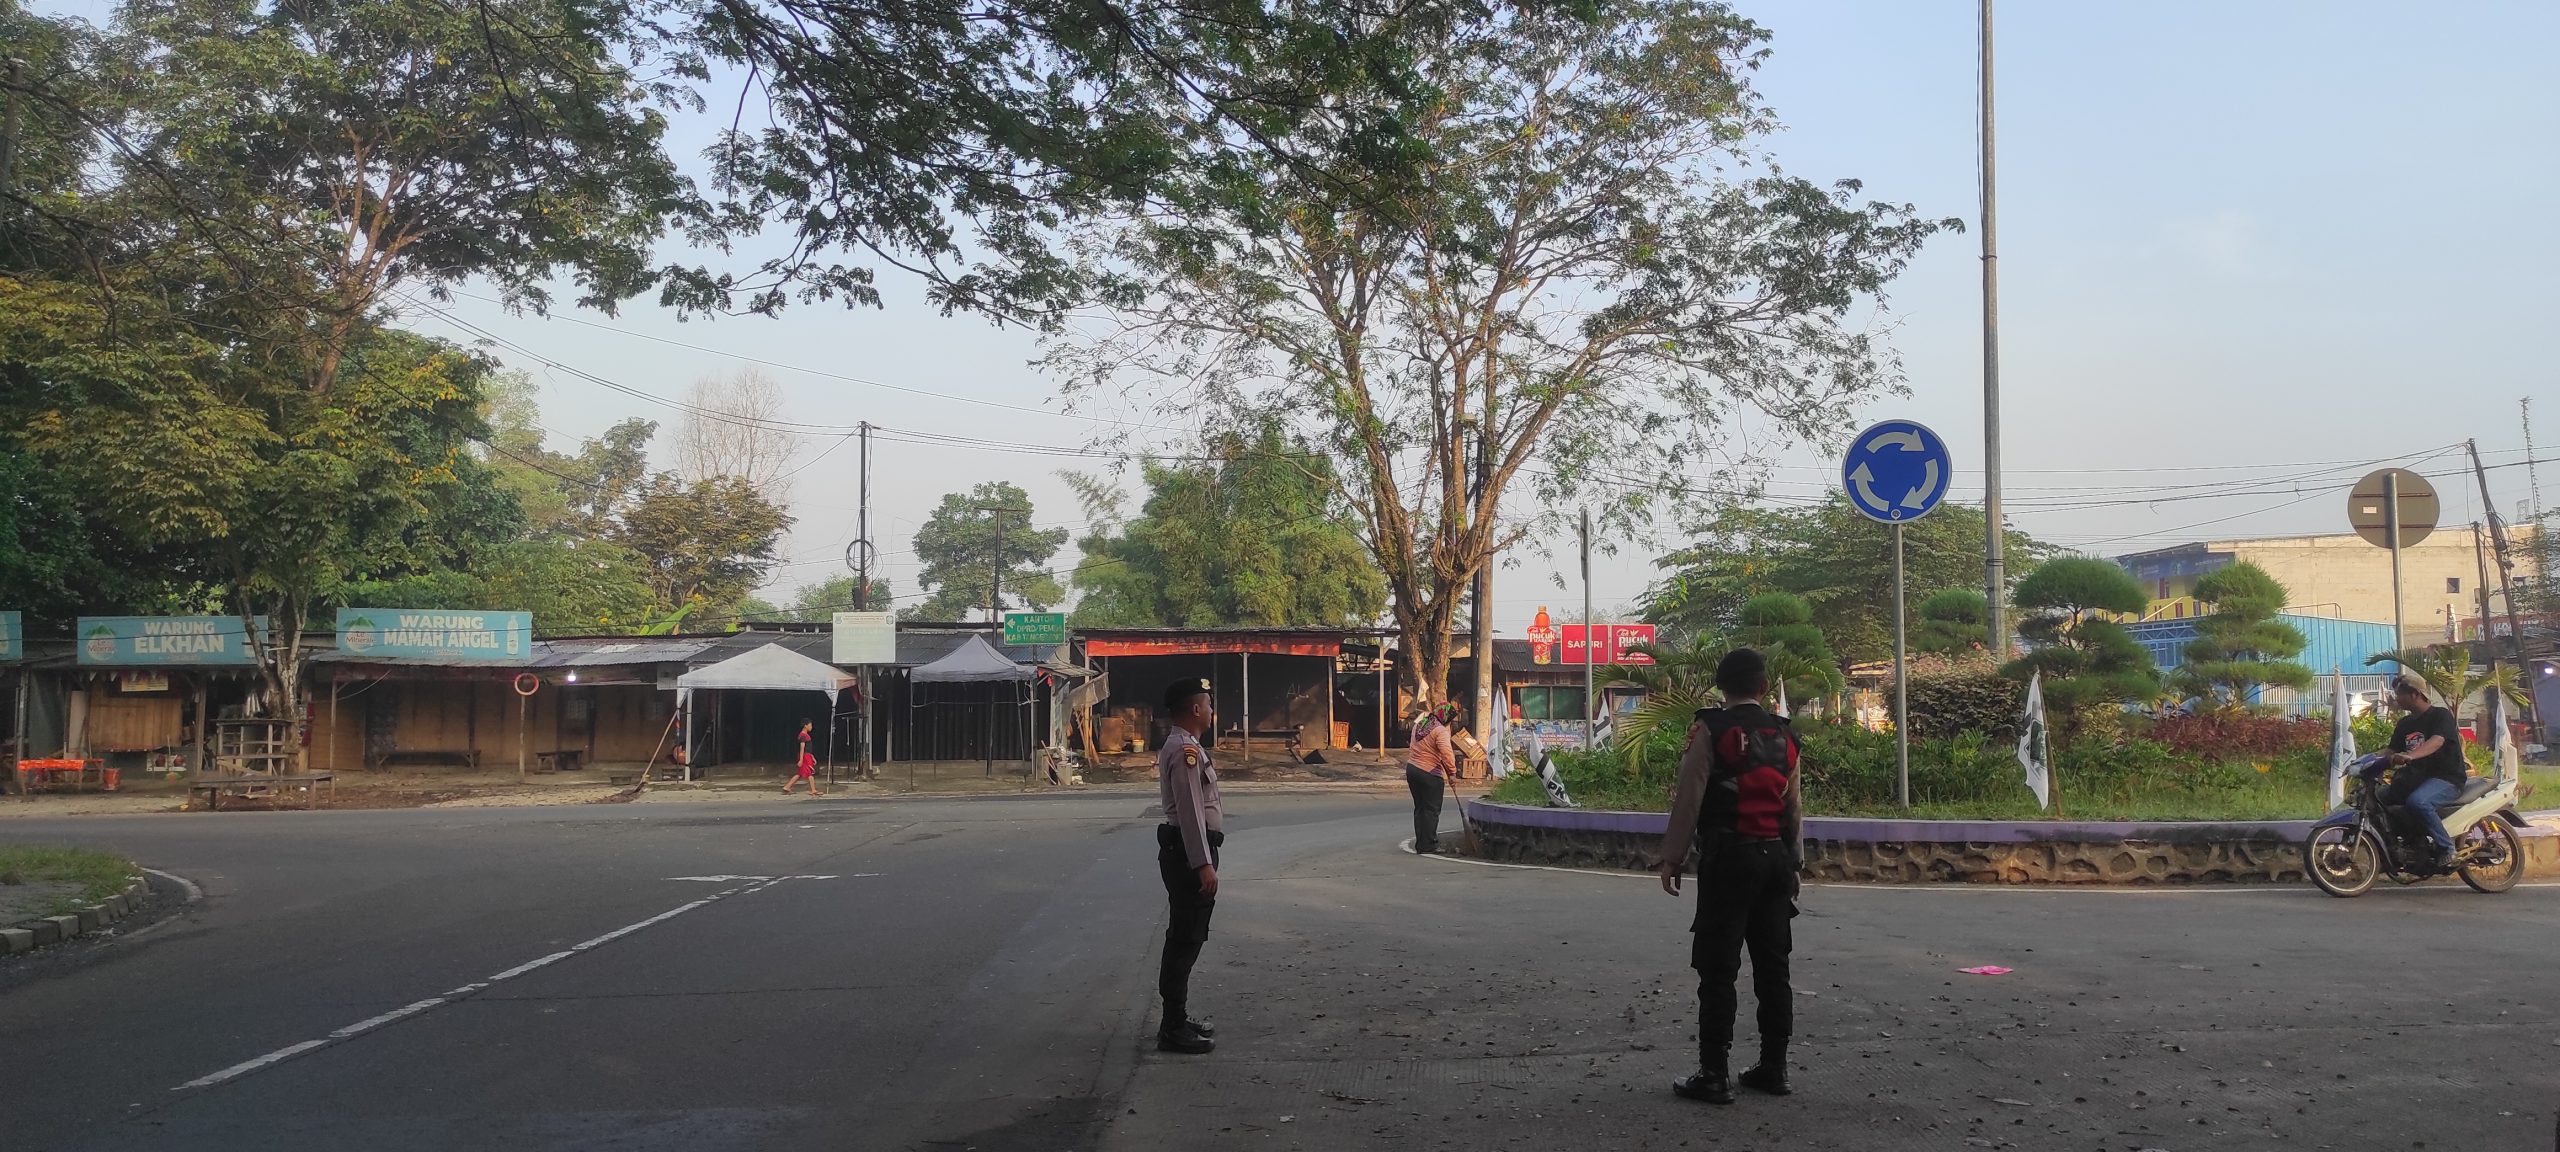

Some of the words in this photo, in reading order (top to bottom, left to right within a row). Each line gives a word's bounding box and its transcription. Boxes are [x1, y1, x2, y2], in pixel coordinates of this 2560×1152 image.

[400, 615, 484, 629] WARUNG
[1024, 615, 1055, 624] KANTOR
[144, 622, 215, 635] WARUNG
[135, 635, 224, 654] ELKHAN
[384, 628, 444, 647] MAMAH
[447, 630, 499, 649] ANGEL
[1567, 640, 1603, 649] SAPRI
